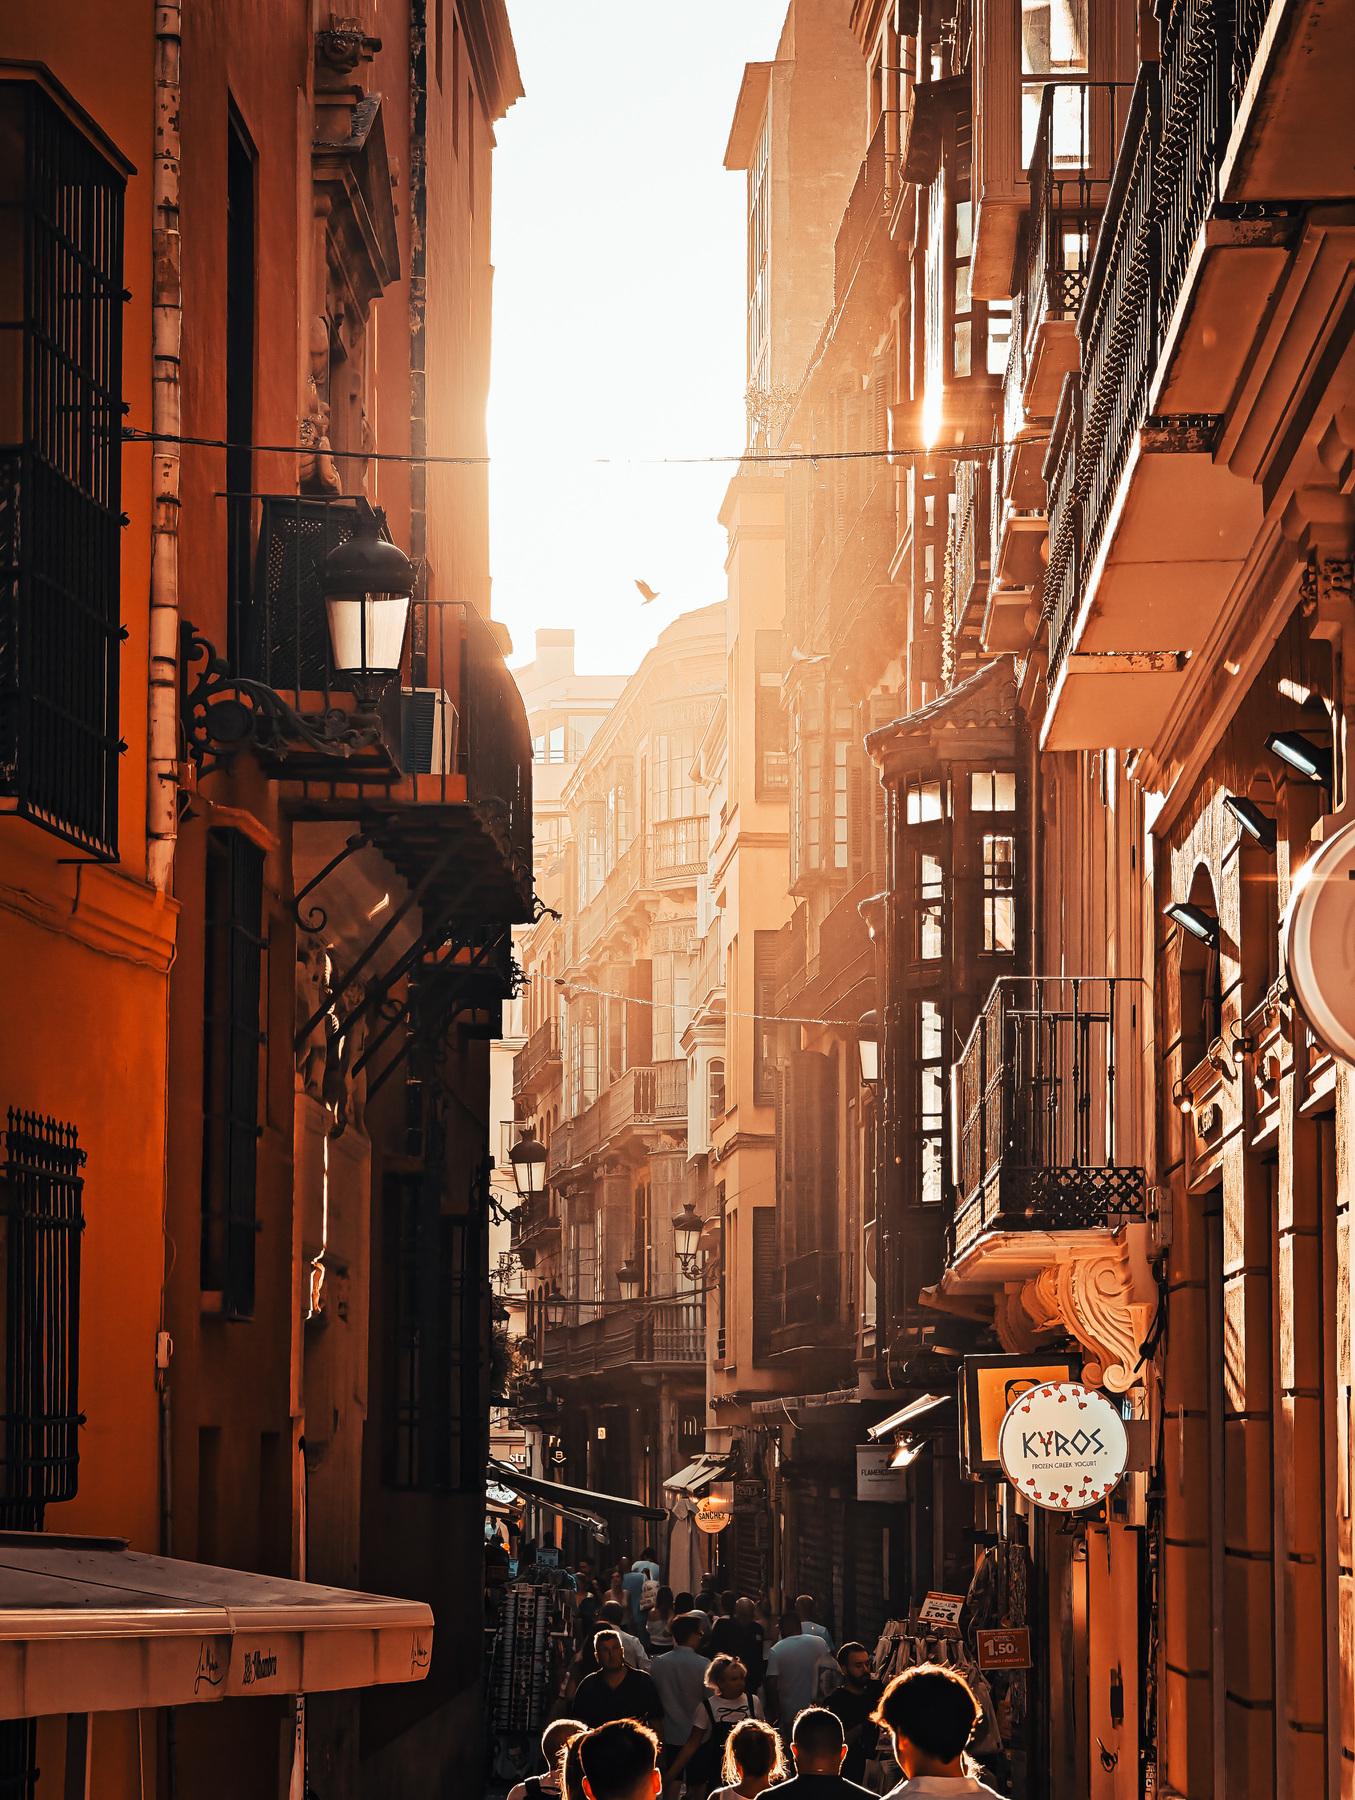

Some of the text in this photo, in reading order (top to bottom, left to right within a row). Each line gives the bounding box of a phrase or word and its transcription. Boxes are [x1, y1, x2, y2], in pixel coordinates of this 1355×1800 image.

[1022, 1428, 1104, 1458] KYROS
[1032, 1460, 1097, 1470] FROZEN GREEK YOGURT
